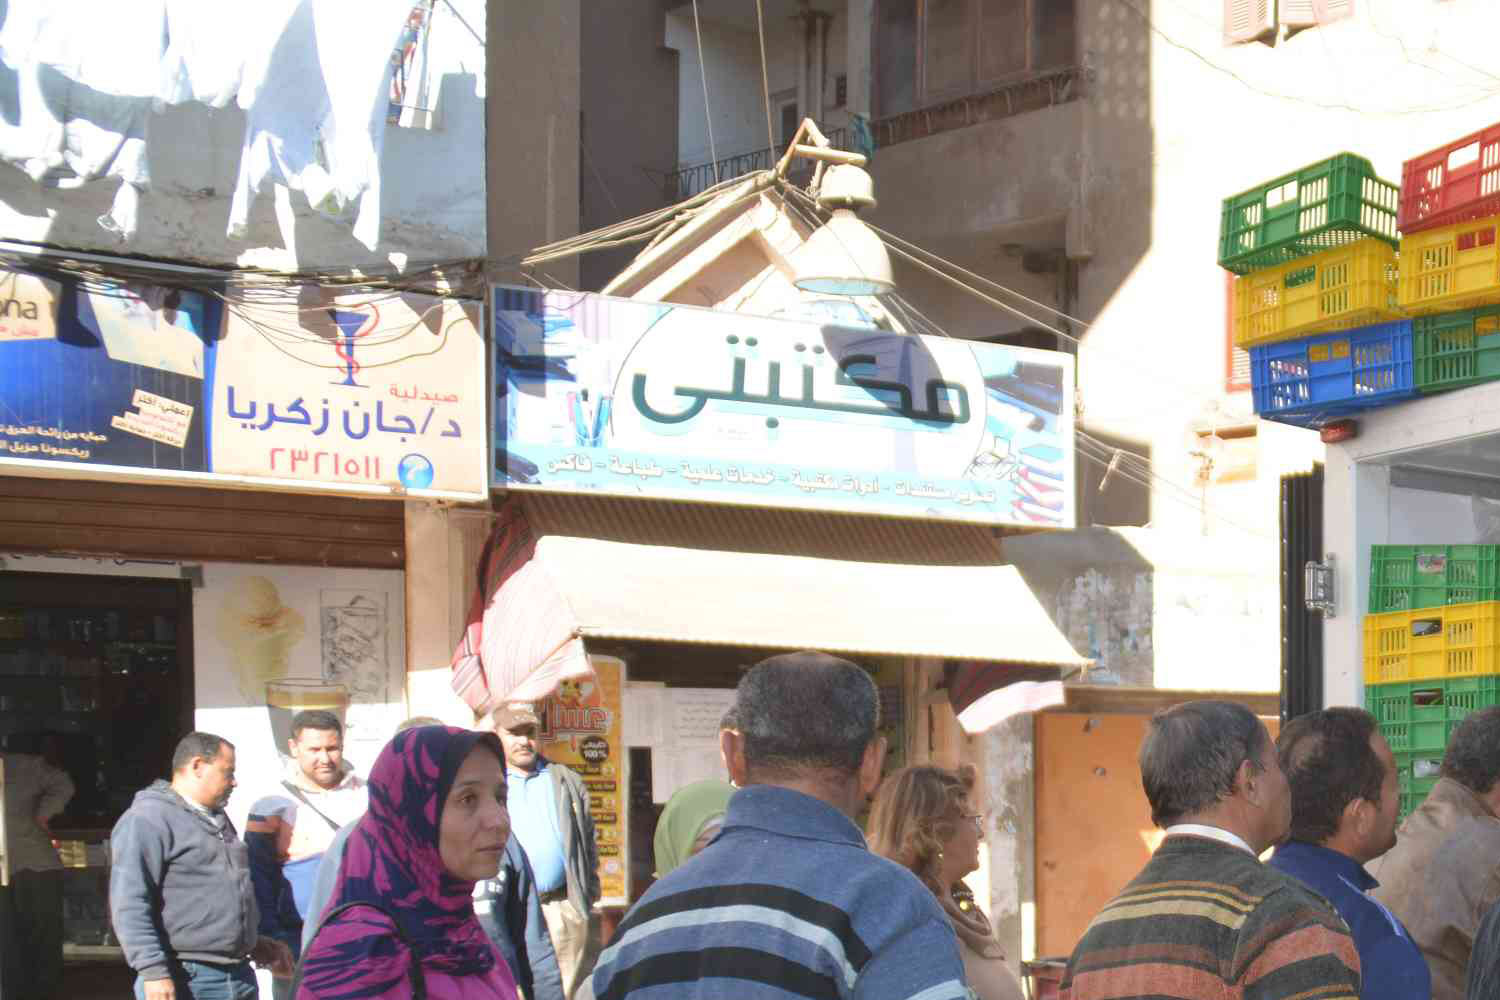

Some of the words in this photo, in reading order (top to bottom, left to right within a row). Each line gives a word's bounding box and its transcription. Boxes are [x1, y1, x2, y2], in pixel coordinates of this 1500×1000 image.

[227, 384, 330, 437] زكريا
[388, 384, 459, 406] صيدلية
[269, 447, 381, 480] ٢٣٢١٥١١
